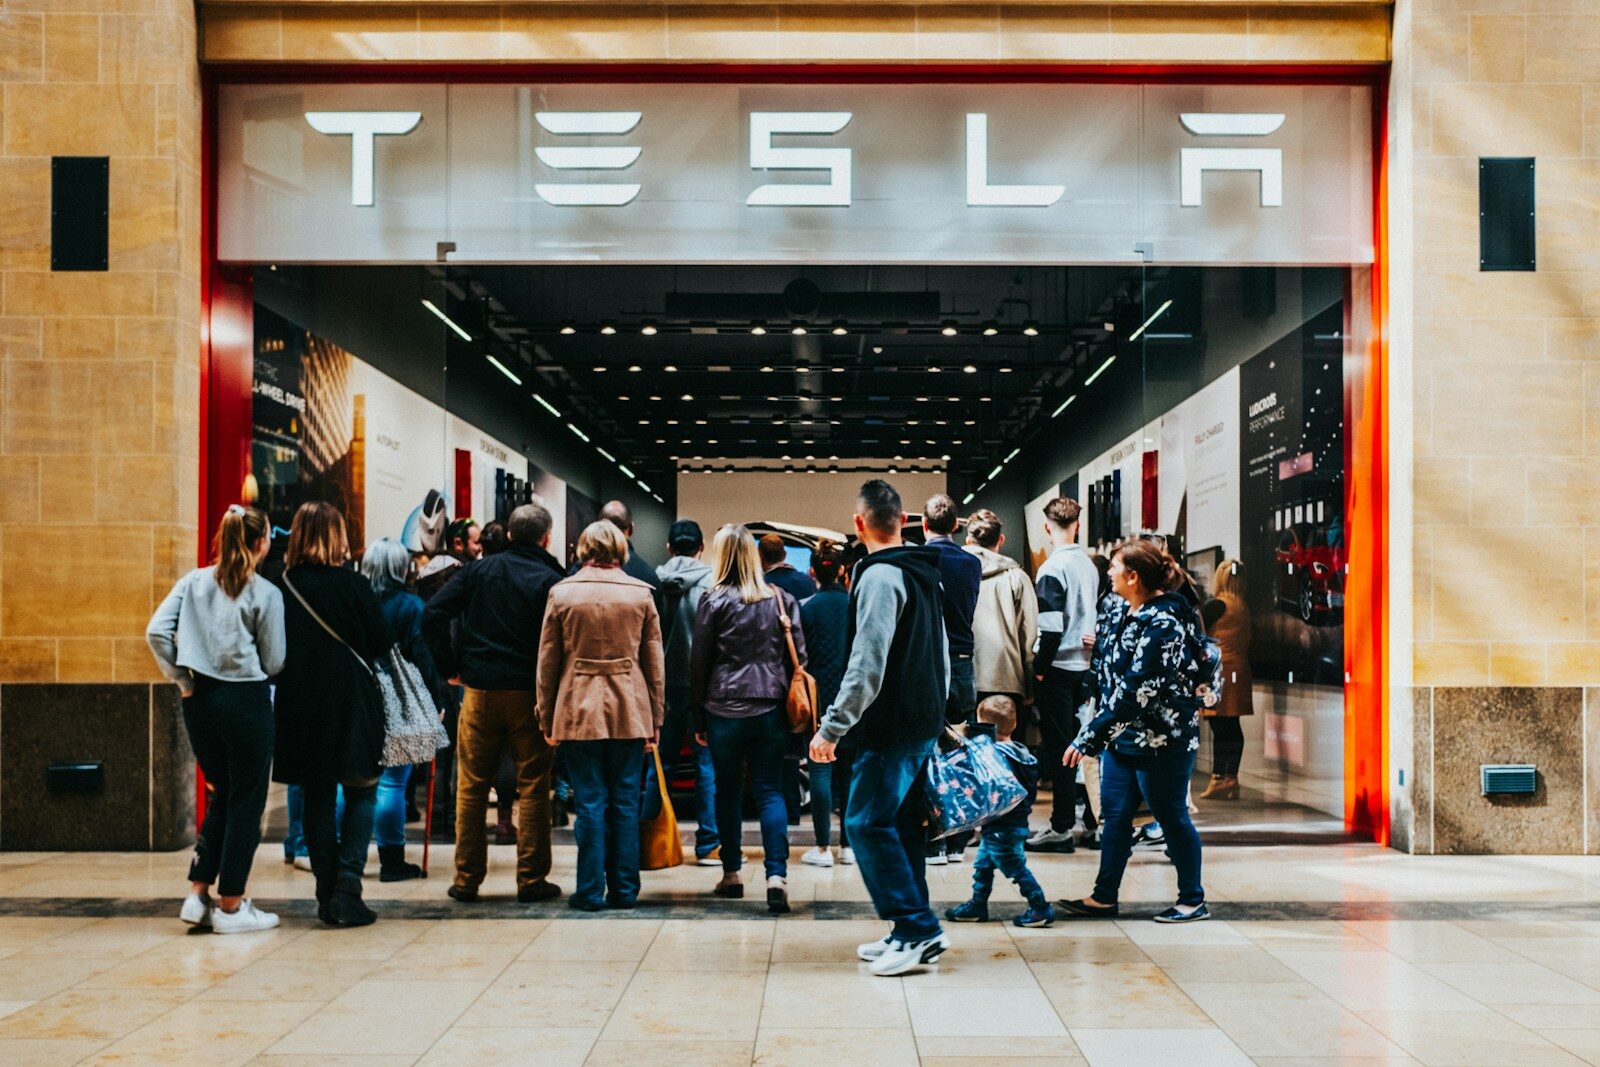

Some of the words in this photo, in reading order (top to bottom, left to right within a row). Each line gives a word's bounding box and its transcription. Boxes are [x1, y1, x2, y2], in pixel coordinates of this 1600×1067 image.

[304, 111, 1287, 208] TESLA
[285, 391, 306, 413] DRIVE
[1248, 392, 1277, 417] LUDICROUS
[1249, 405, 1286, 433] PERFORMANCE
